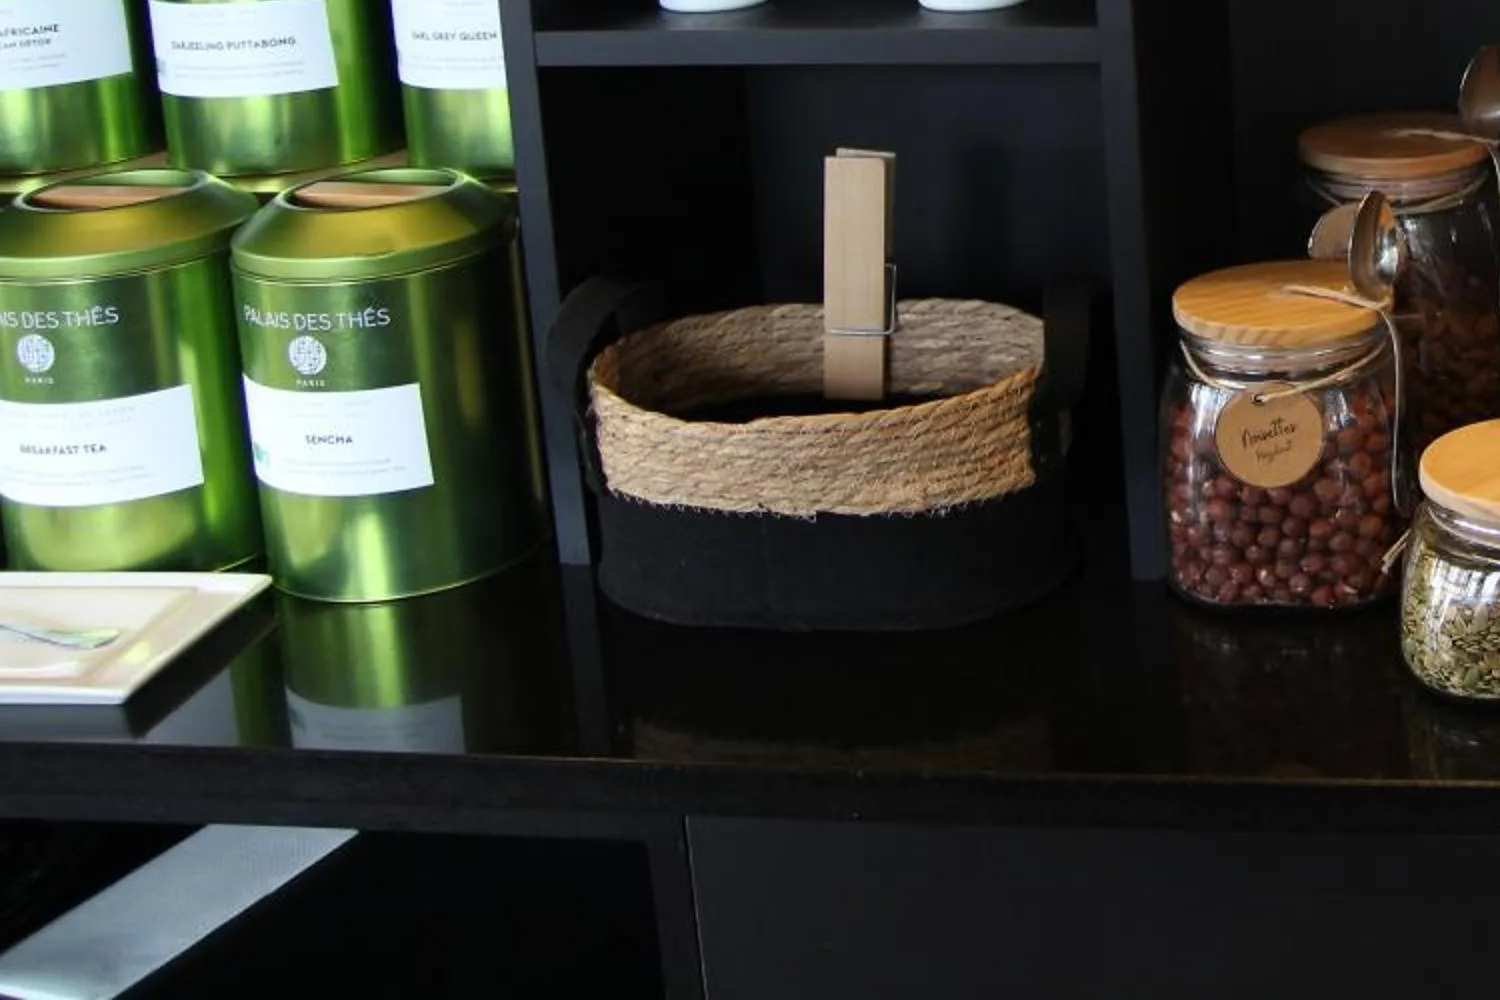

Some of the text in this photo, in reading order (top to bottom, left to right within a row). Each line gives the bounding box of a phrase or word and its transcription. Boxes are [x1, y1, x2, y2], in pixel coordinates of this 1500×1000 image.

[22, 311, 59, 329] DES
[62, 305, 119, 327] THÉS
[243, 304, 391, 331] PALAIS DES THÉS
[83, 442, 108, 454] TEA
[305, 434, 354, 446] SENCHA
